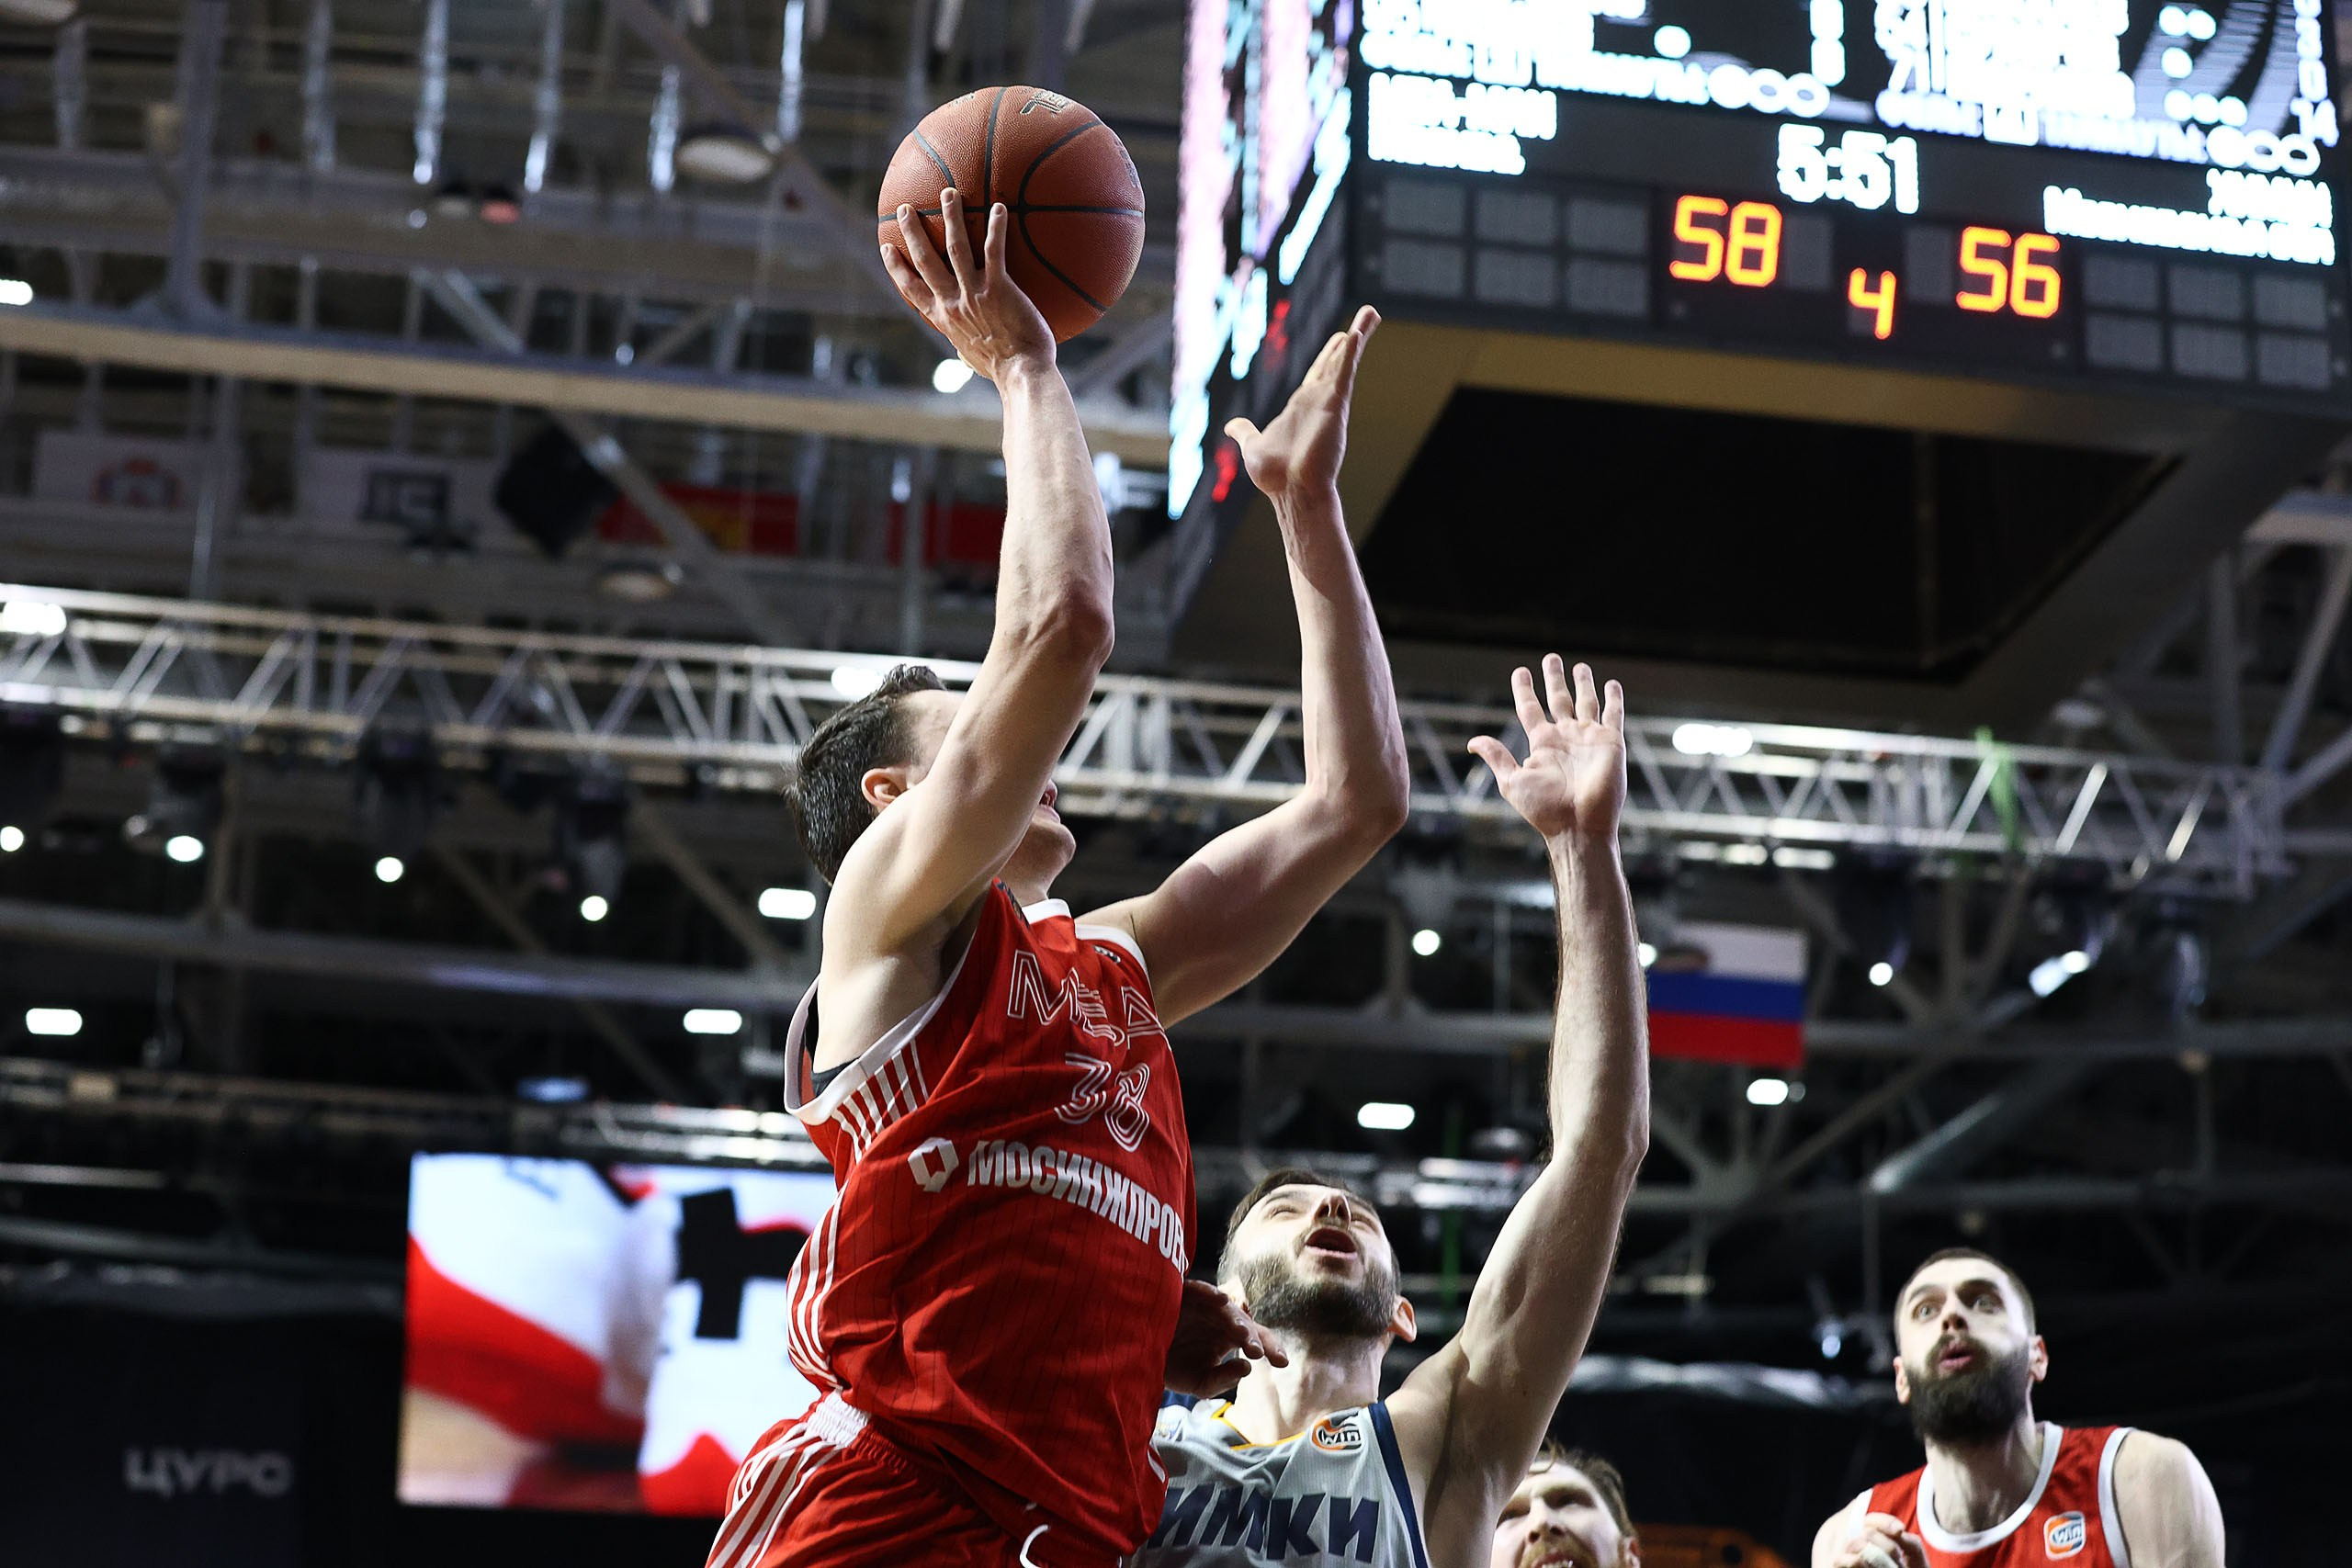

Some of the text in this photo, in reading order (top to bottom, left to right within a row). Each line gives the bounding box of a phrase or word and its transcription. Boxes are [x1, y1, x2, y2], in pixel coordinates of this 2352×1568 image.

[1778, 123, 1919, 214] 5:51
[1669, 195, 1782, 287] 58
[1956, 226, 2061, 319] 56
[1848, 267, 1897, 340] 4
[1054, 1051, 1151, 1153] 38
[967, 1139, 1189, 1284] МОСИНЖПРОЕ
[1147, 1483, 1379, 1563] ИМКИ
